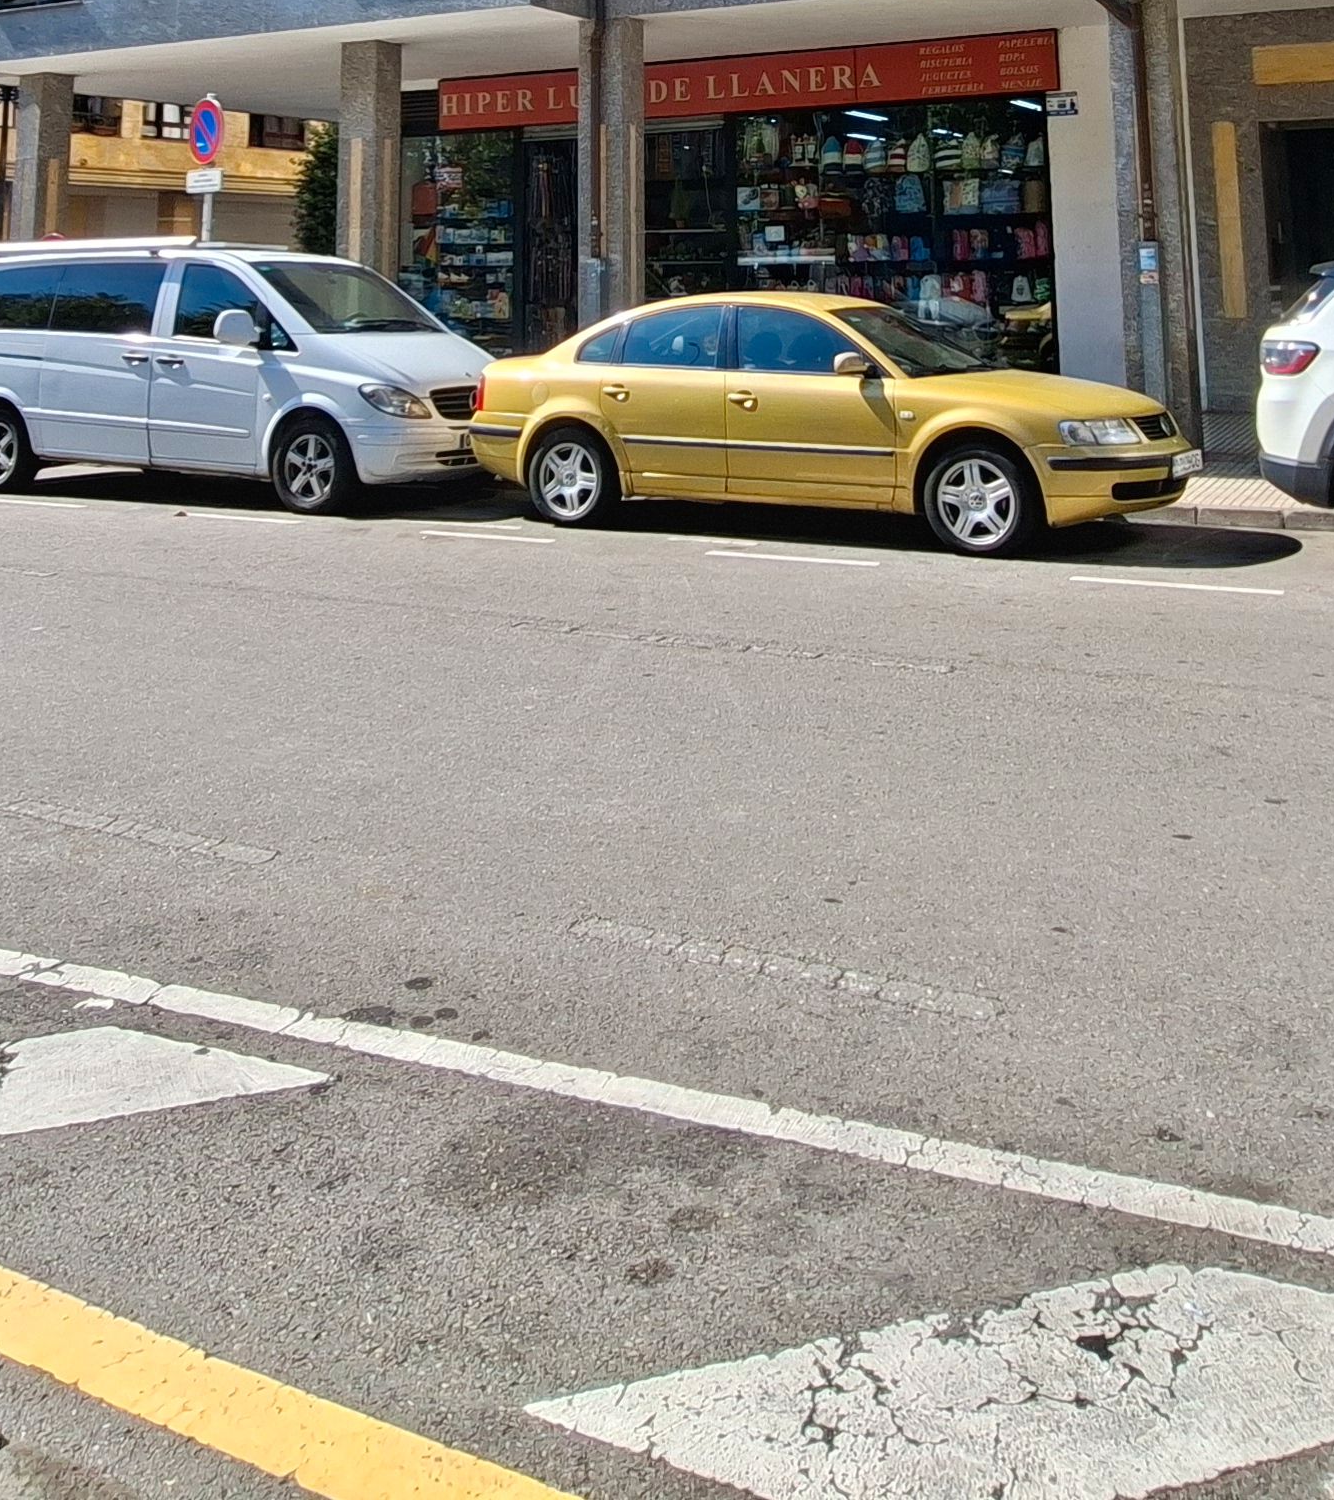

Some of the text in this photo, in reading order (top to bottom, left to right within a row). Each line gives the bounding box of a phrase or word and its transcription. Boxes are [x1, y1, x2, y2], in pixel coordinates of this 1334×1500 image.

[919, 44, 965, 55] REGALOS
[998, 52, 1026, 63] ROPA
[441, 89, 535, 116] HIPER
[649, 77, 691, 103] DE
[705, 63, 883, 99] LLANERA
